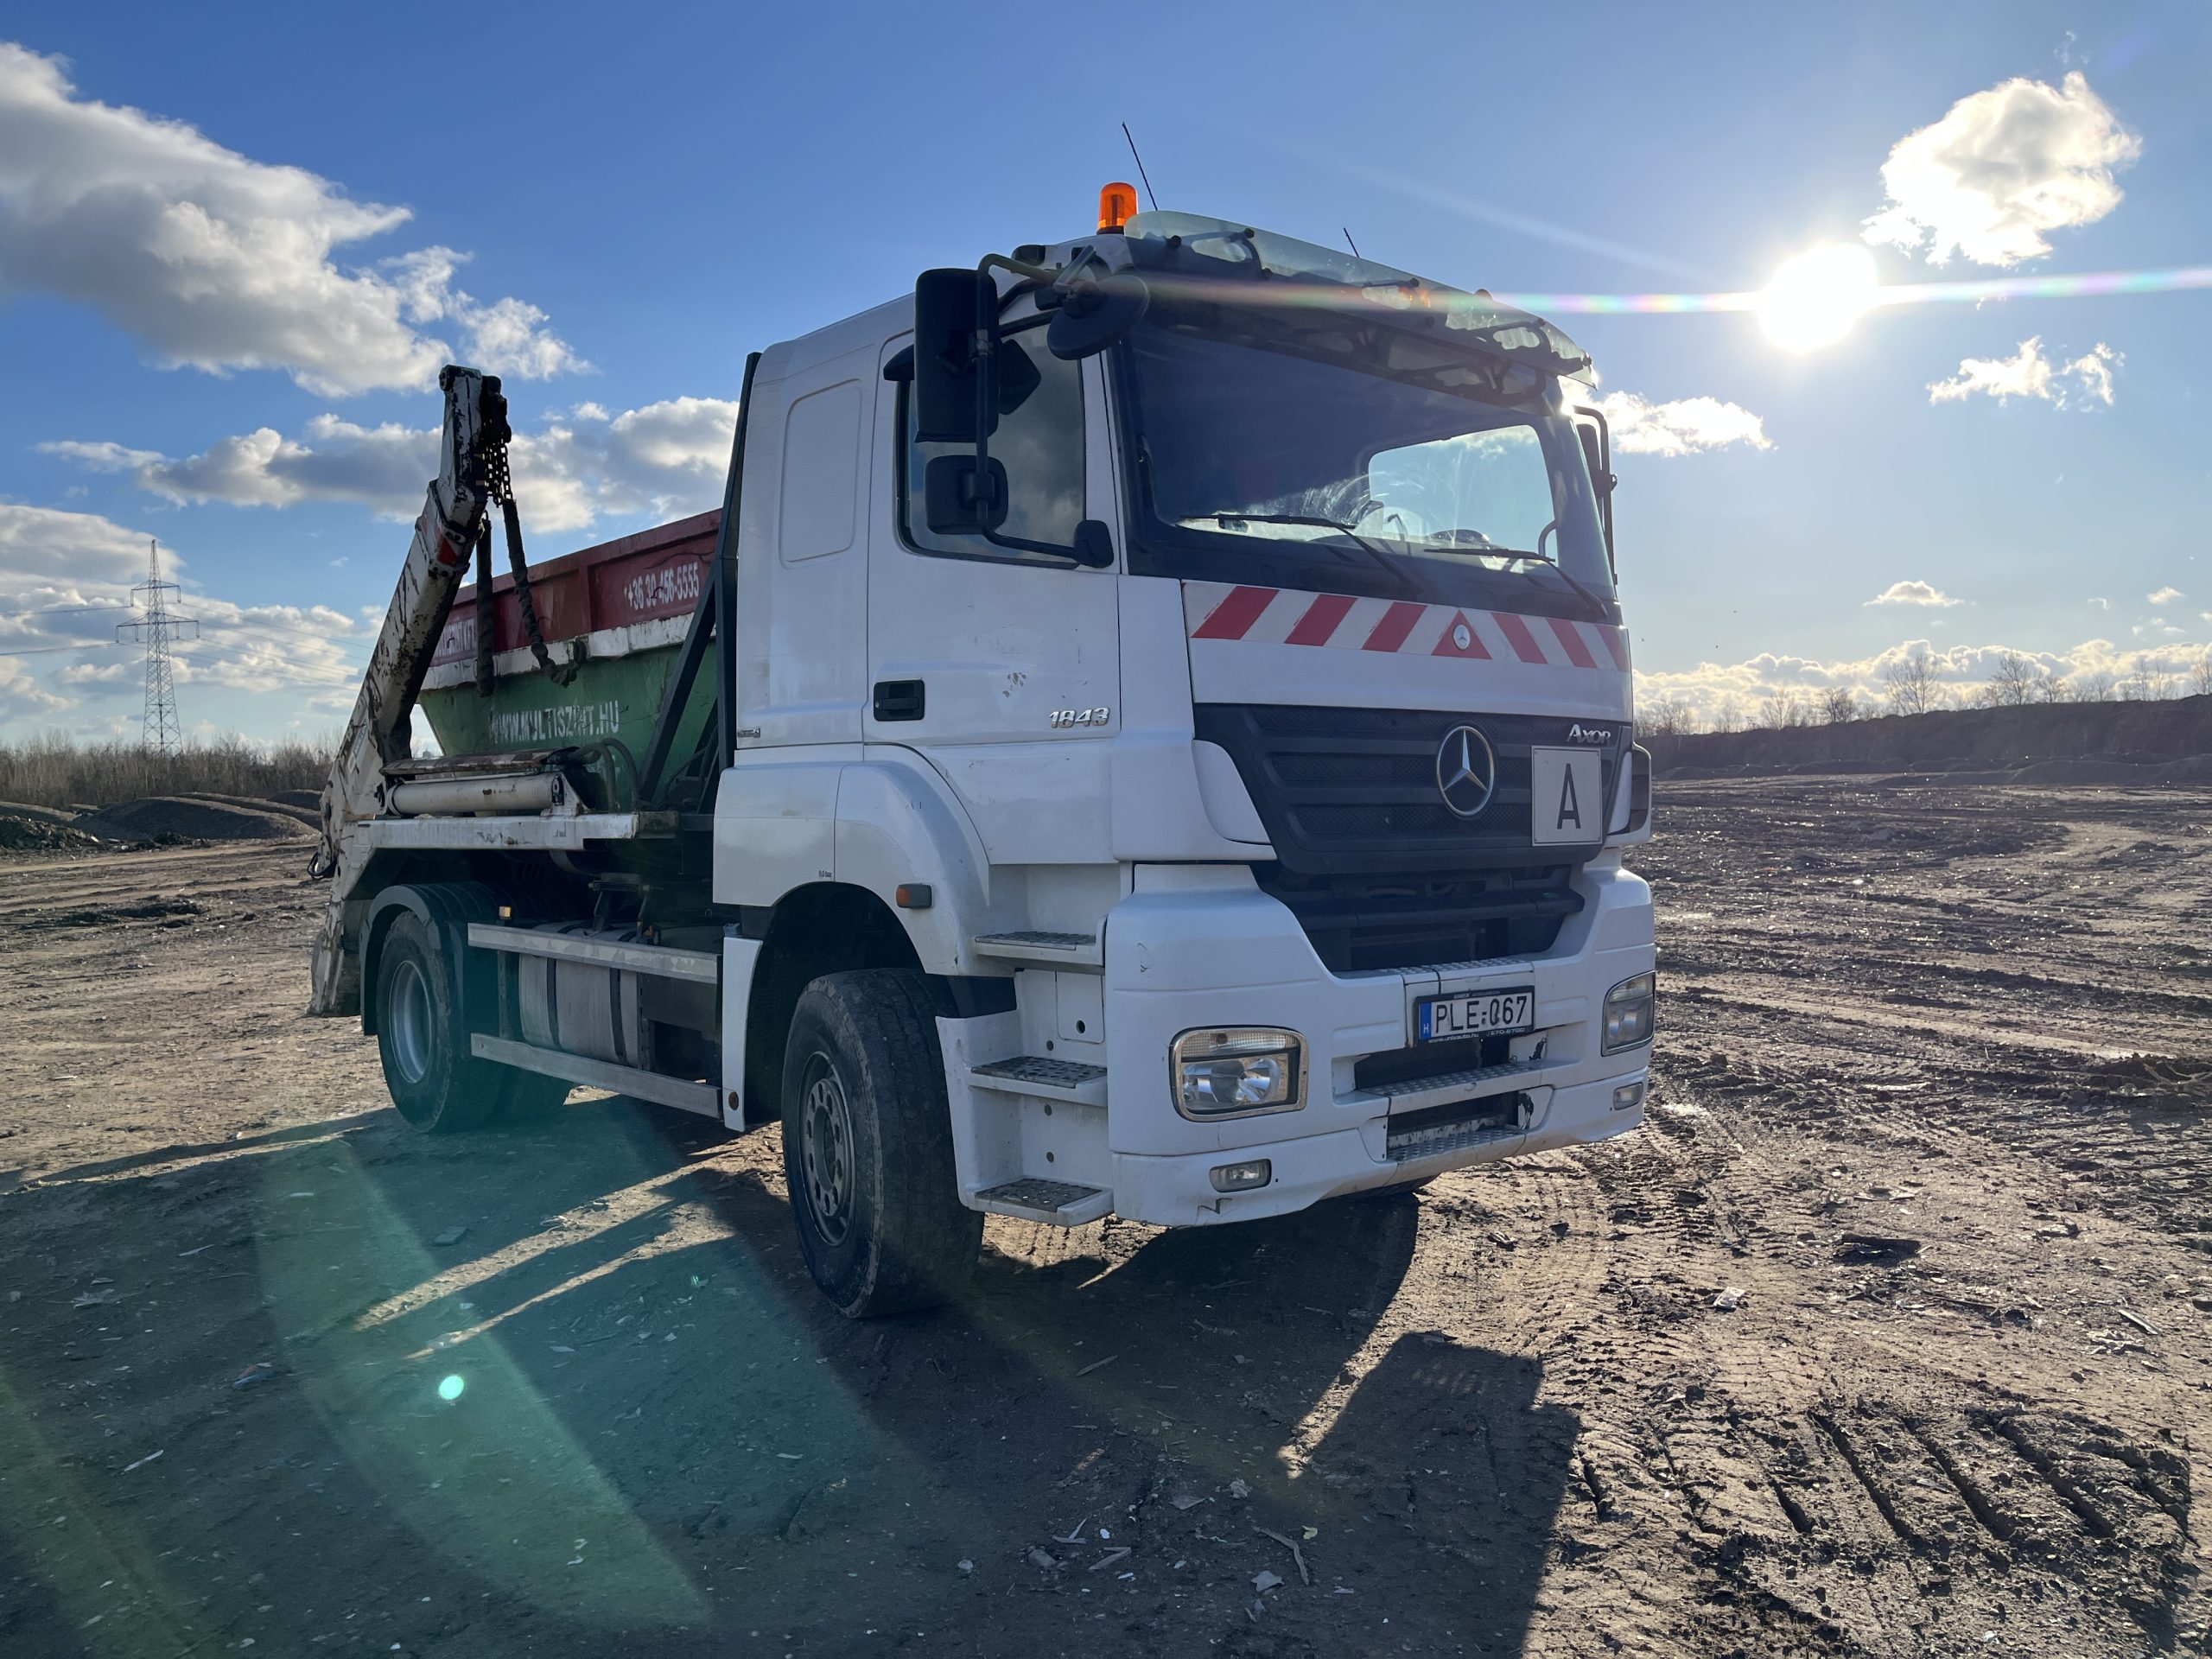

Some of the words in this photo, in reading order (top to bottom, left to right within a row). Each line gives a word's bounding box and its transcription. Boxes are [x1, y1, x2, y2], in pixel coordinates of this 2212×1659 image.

[1048, 707, 1110, 728] 1843
[1556, 762, 1581, 830] A
[1422, 1022, 1430, 1033] H
